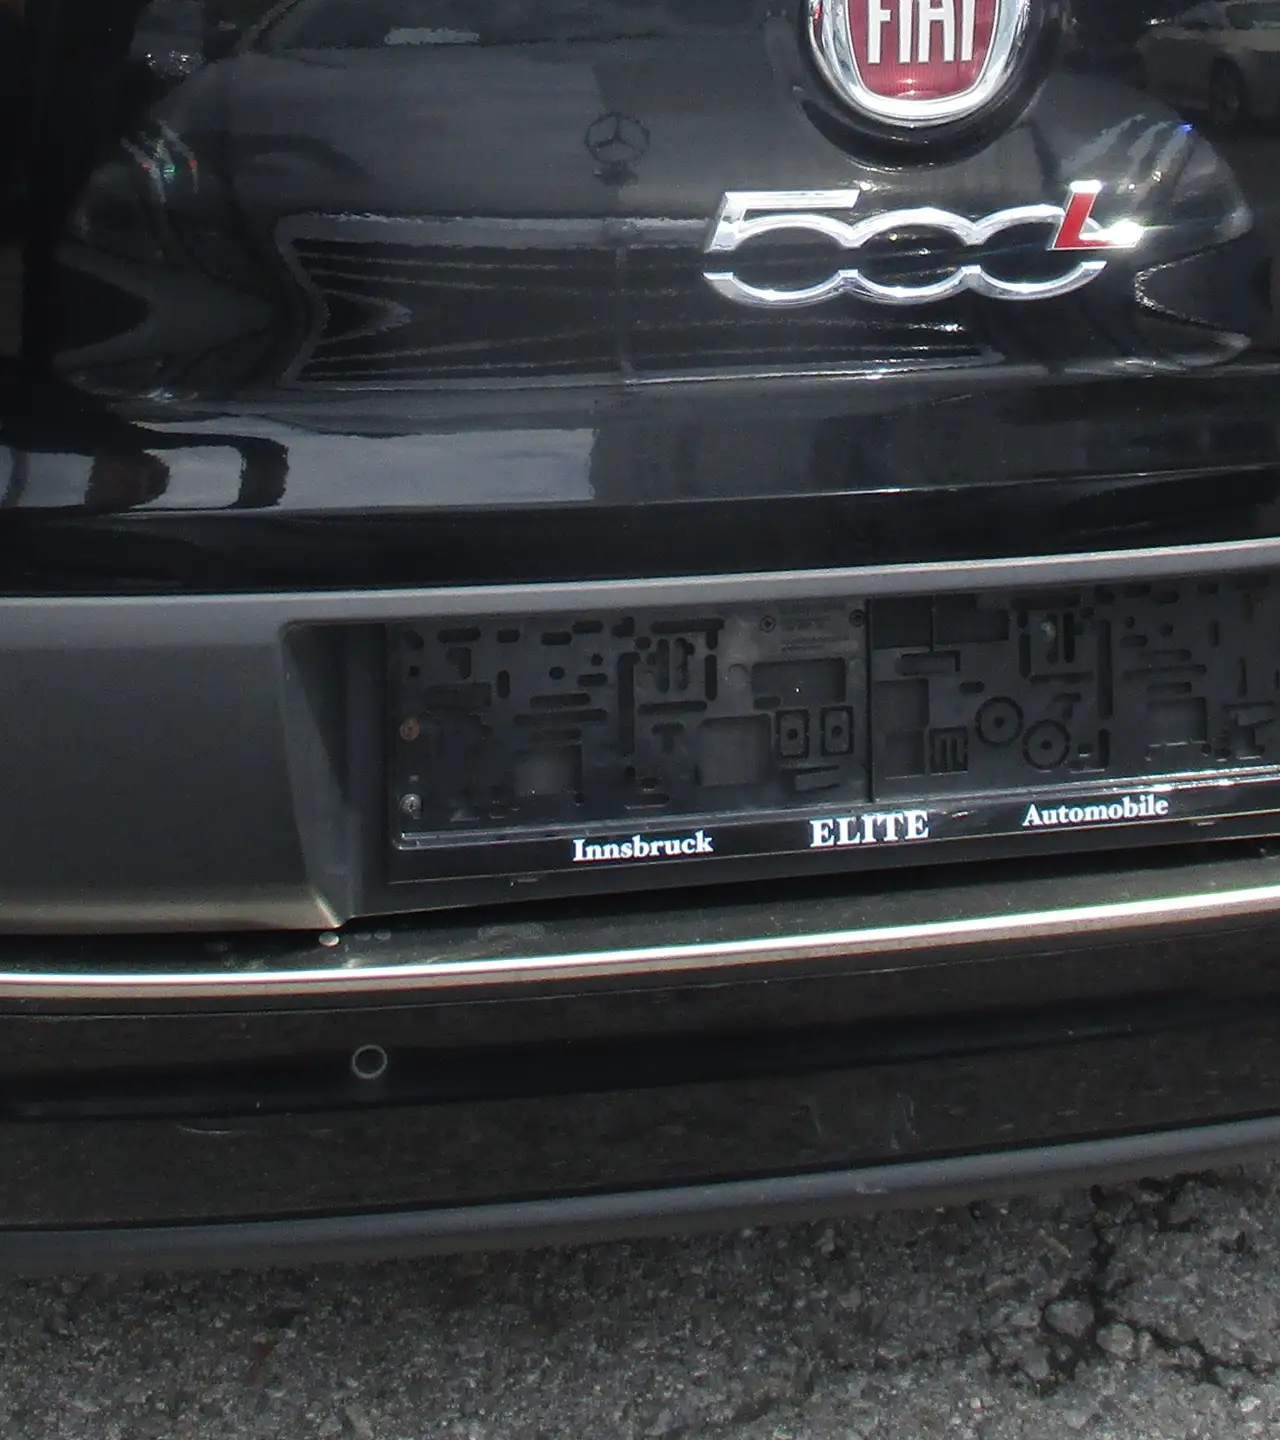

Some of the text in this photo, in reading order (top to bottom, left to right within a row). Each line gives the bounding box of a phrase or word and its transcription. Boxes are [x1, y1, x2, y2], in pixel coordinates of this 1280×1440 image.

[703, 180, 1144, 308] 500L
[572, 795, 1169, 862] Innsbruck ELITE Automobile
